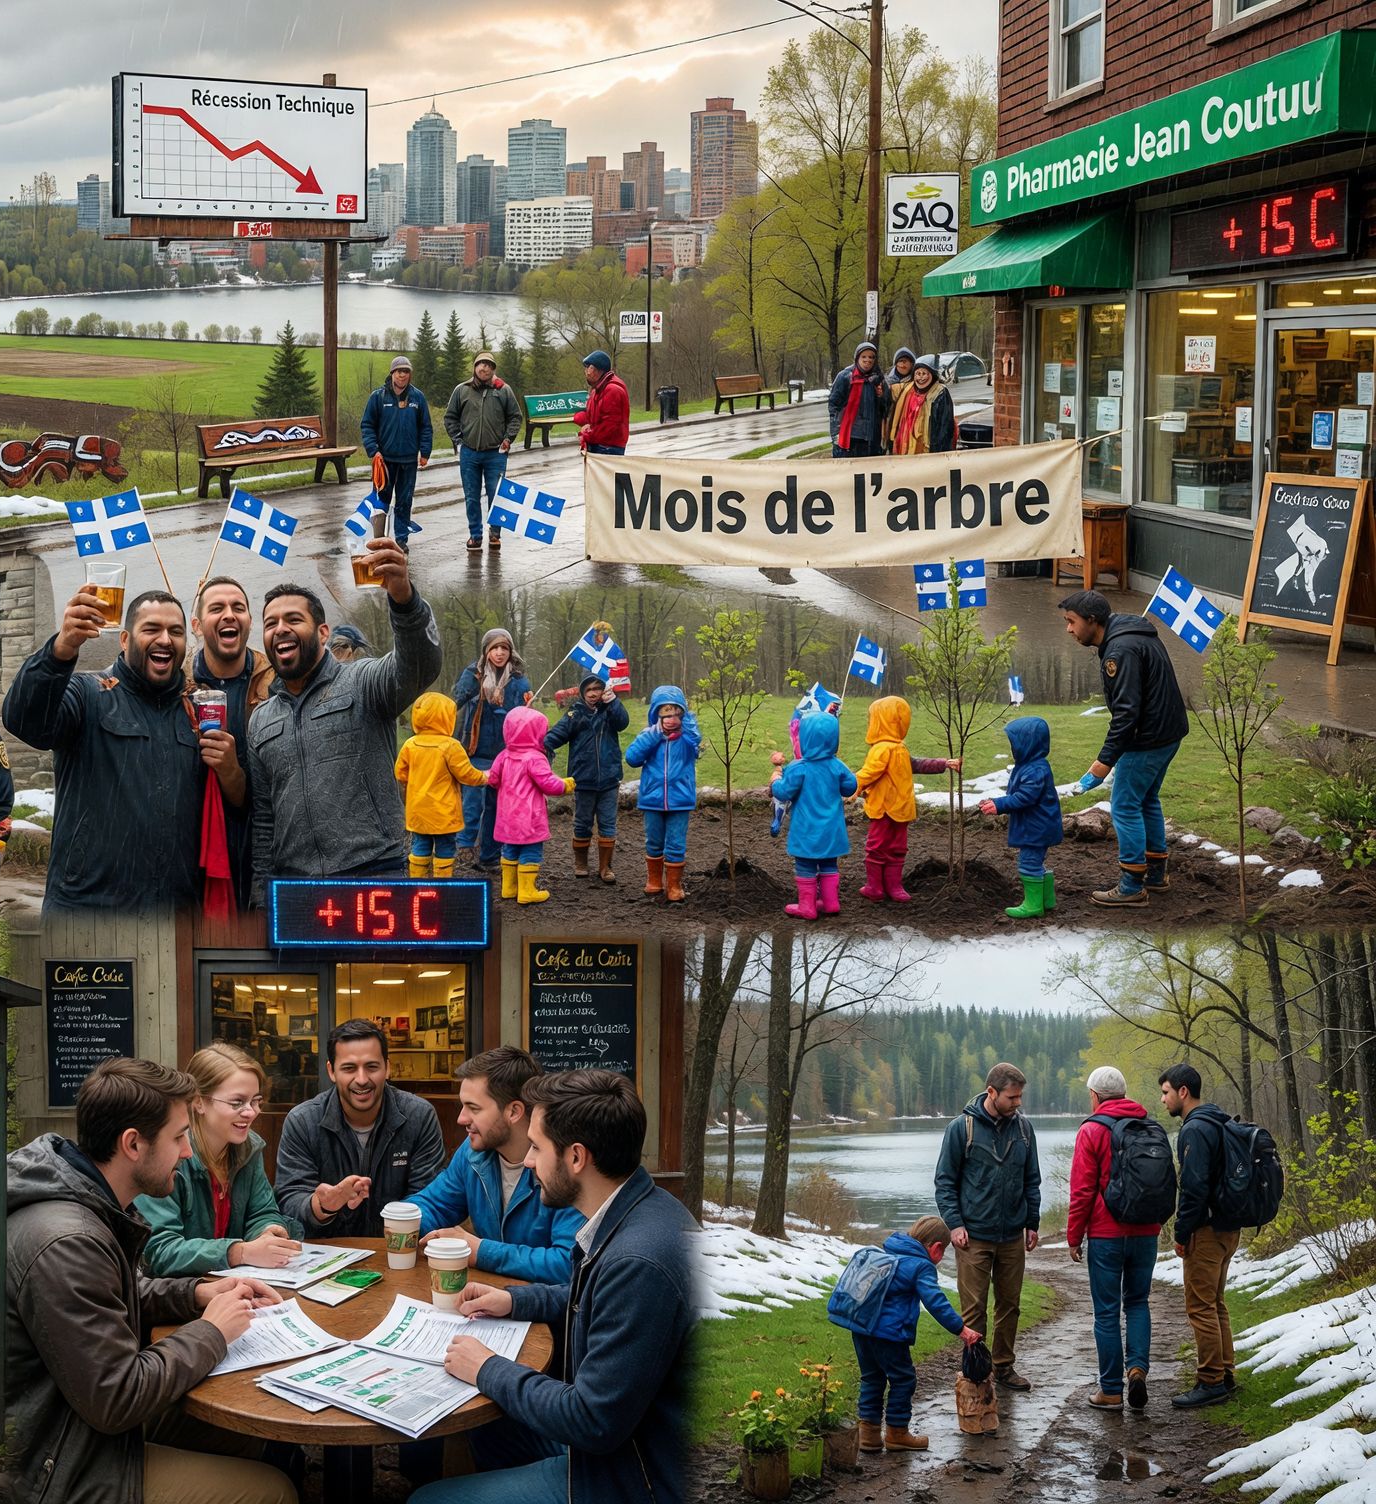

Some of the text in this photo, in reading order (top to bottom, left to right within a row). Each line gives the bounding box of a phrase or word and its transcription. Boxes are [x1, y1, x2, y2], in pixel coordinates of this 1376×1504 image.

[191, 89, 355, 117] Récession Technique
[1007, 136, 1119, 202] Pharmacie
[1126, 119, 1190, 168] Jean
[892, 202, 957, 233] SAQ
[614, 472, 747, 534] Mois
[764, 475, 834, 535] de
